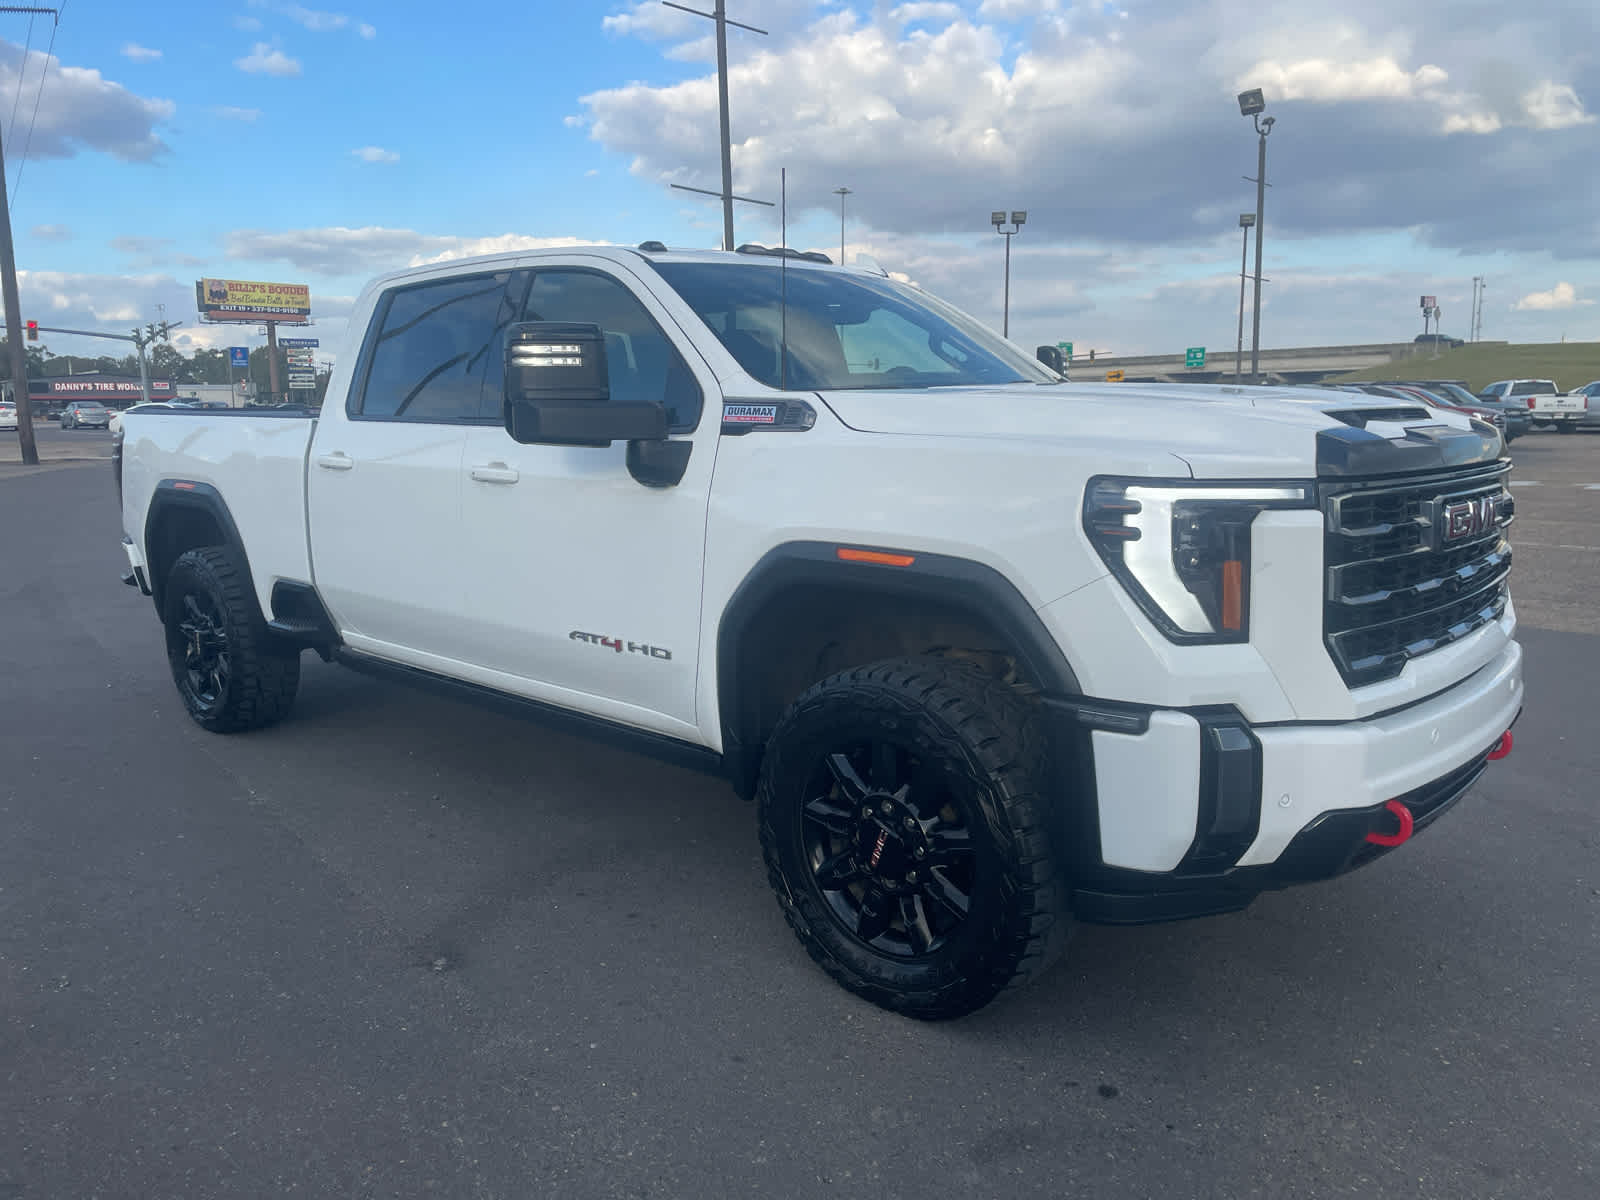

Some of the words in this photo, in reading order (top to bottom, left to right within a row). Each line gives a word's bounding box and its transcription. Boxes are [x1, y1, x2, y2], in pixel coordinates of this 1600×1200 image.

[228, 282, 266, 293] BILLY'S
[268, 285, 307, 296] BOUDIN
[55, 383, 93, 391] DANNY'S
[95, 383, 115, 391] TIRE
[727, 407, 774, 416] DURAMAX
[1445, 494, 1505, 539] GMC
[569, 630, 623, 653] AT4
[627, 641, 672, 660] HD
[870, 829, 889, 868] GMC
